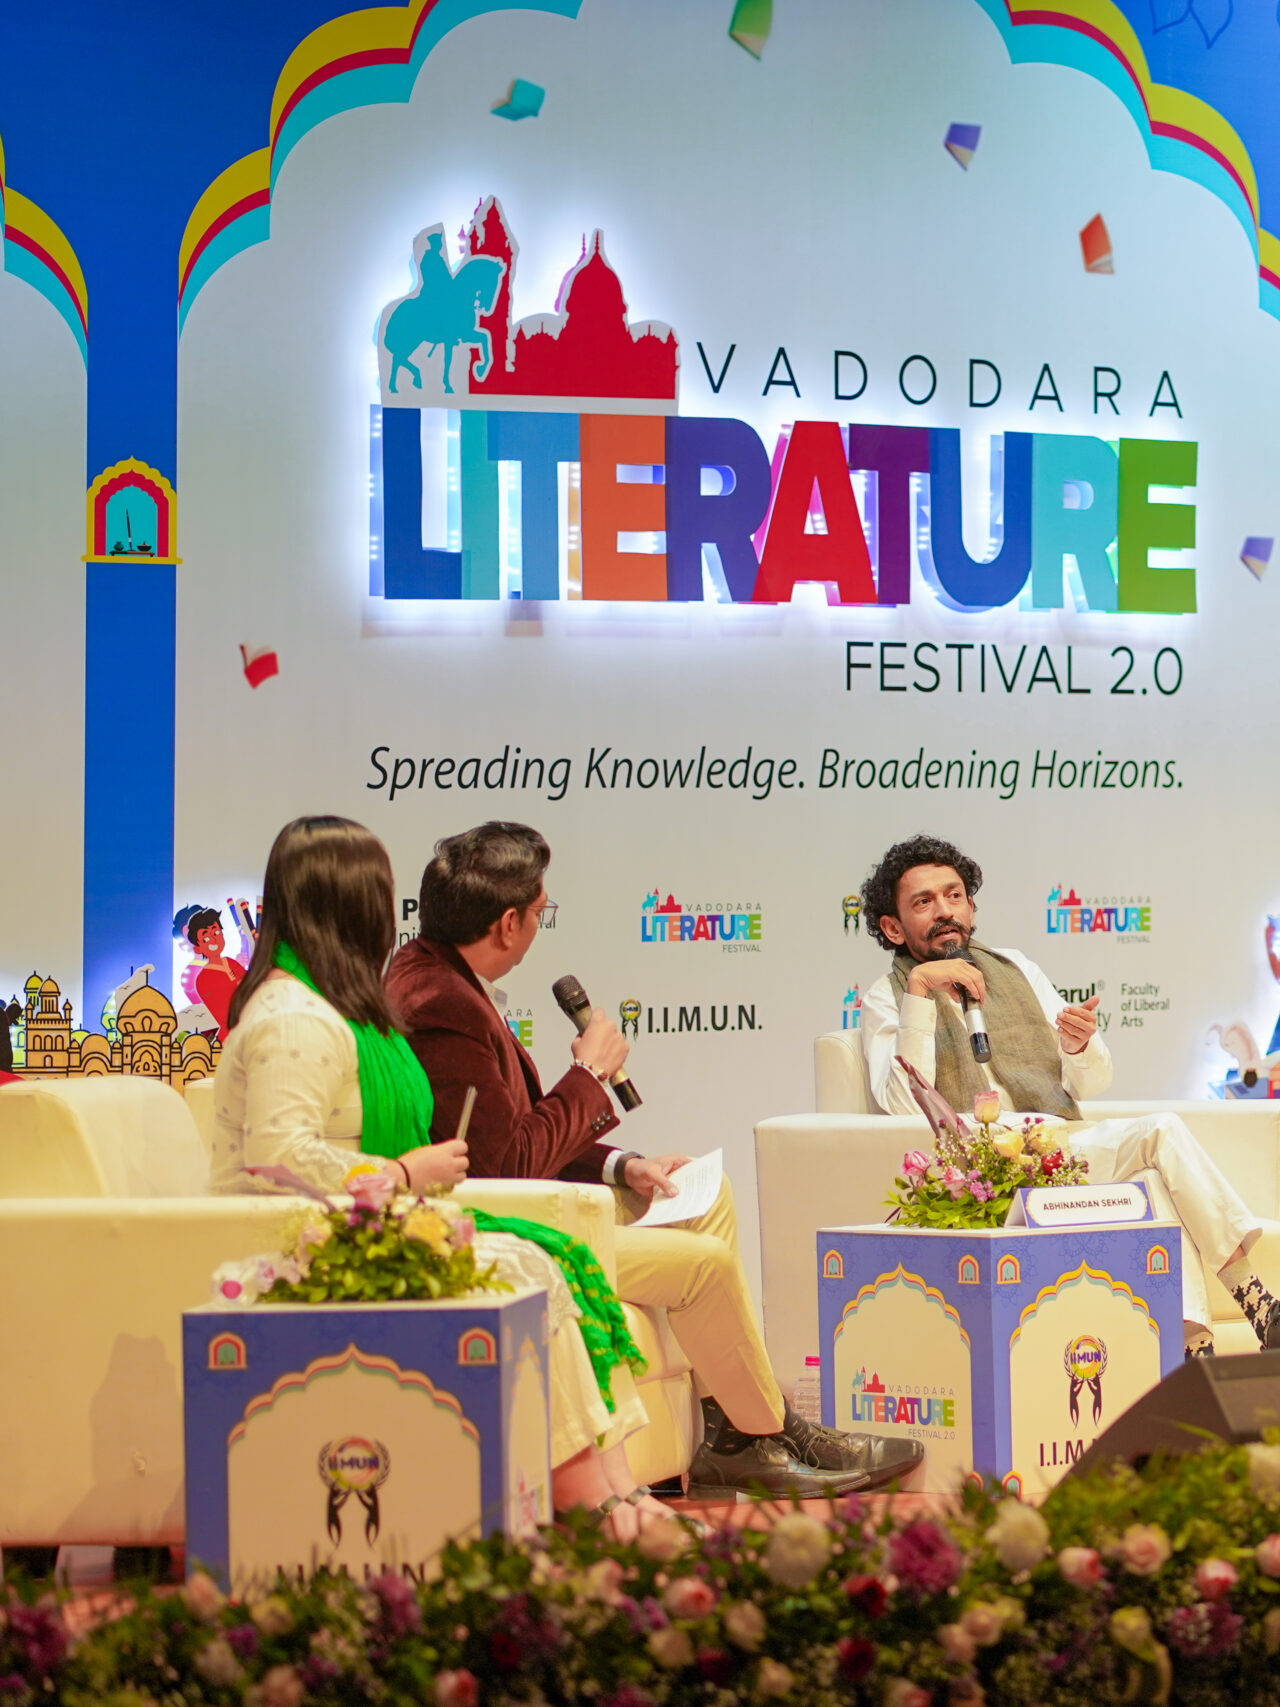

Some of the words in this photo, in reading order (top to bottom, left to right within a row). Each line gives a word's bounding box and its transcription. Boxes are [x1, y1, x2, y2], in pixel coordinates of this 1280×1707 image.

[696, 341, 1185, 419] VADODARA
[378, 406, 1198, 615] LITERATURE
[845, 641, 1091, 694] FESTIVAL
[1110, 645, 1185, 697] 2.0
[366, 744, 572, 801] Spreading
[583, 746, 806, 801] Knowledge.
[818, 748, 1019, 799] Broadening
[1030, 749, 1184, 791] Horizons.
[686, 902, 762, 912] VADODARA
[641, 913, 762, 942] LITERATURE
[1047, 907, 1151, 934] LITERATURE
[722, 944, 762, 953] FESTIVAL
[1121, 983, 1160, 996] Faculty
[1120, 1000, 1132, 1012] of
[1133, 998, 1170, 1011] Liberal
[647, 1004, 763, 1034] I.I.M.U.N.
[1121, 1015, 1144, 1027] Arts
[1043, 1199, 1100, 1211] ABHINANDAN
[1101, 1197, 1132, 1207] SEKHRI
[889, 1384, 955, 1396] VADODARA
[851, 1393, 955, 1427] LITERATURE
[908, 1428, 942, 1440] FESTIVAL
